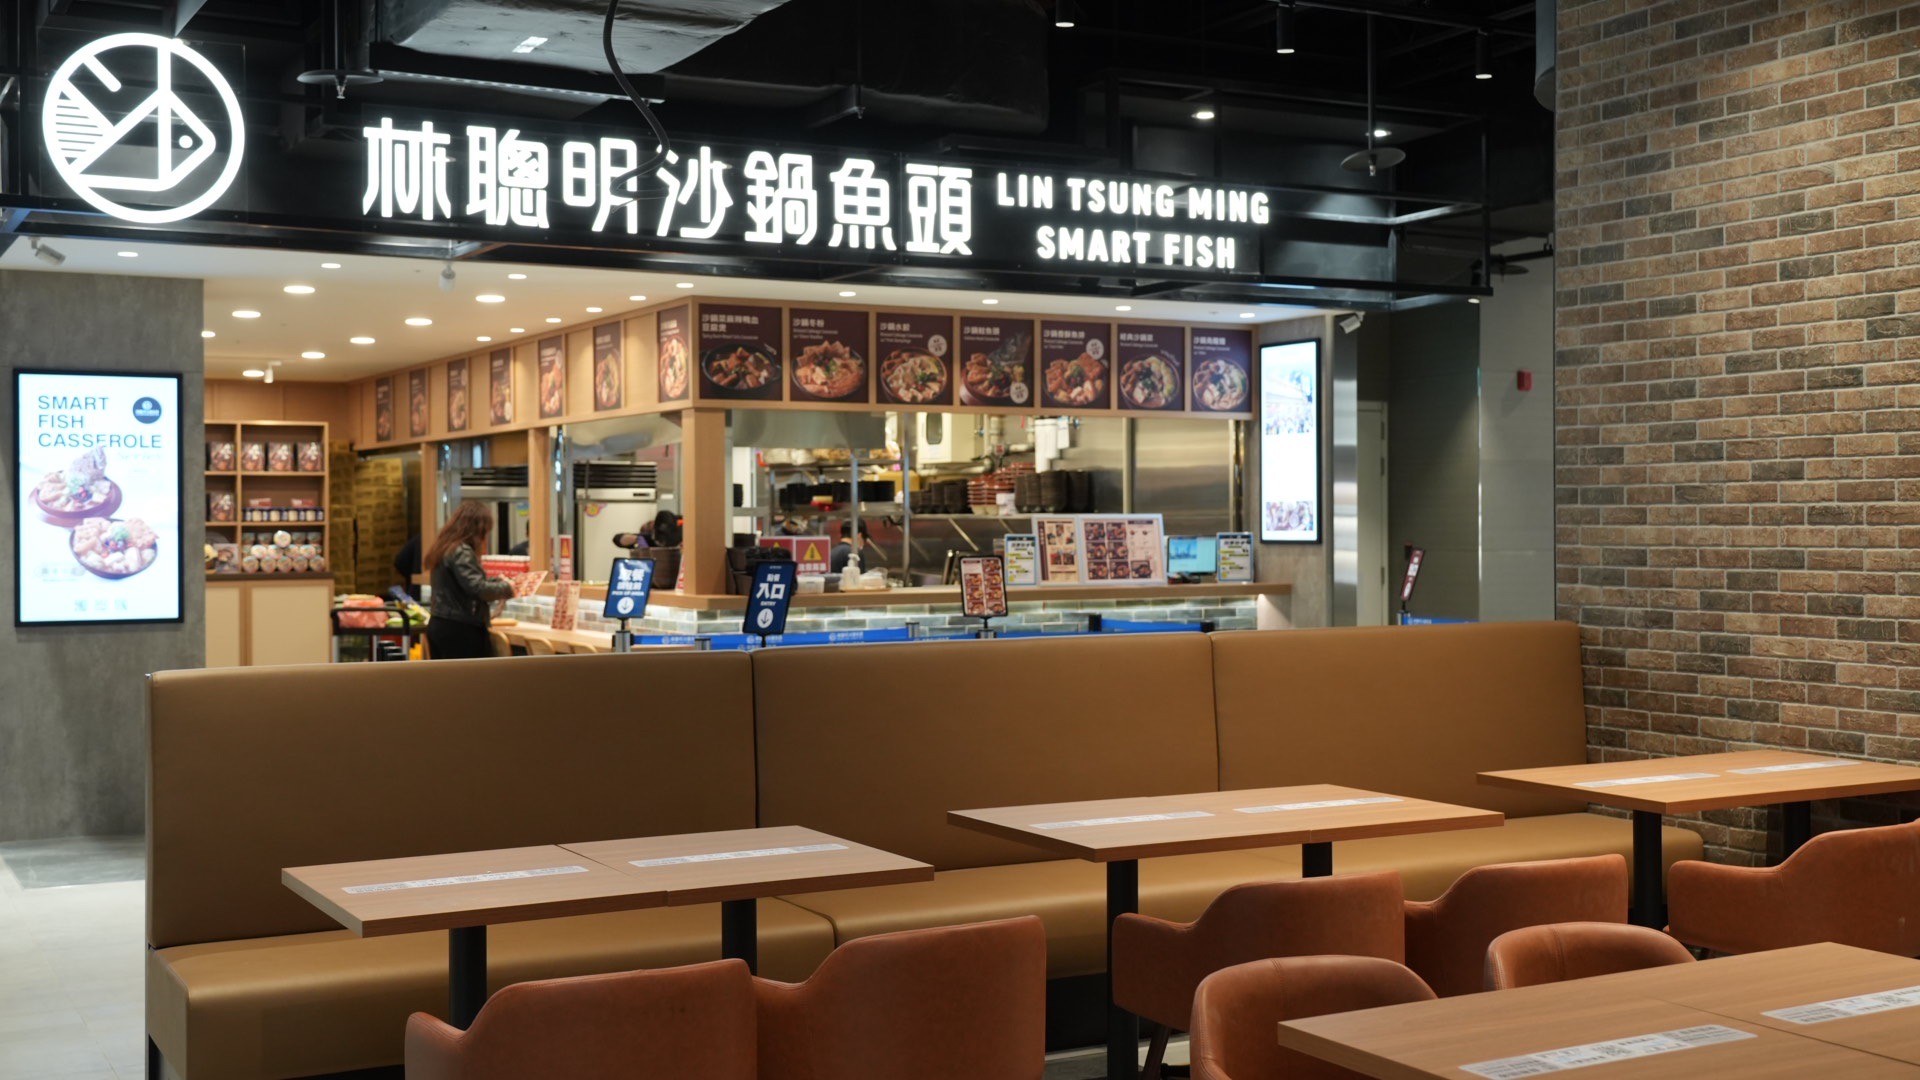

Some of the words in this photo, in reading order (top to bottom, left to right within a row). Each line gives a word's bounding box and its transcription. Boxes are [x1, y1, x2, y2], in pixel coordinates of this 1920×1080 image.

[363, 117, 973, 256] 林聰明沙鍋魚頭
[997, 172, 1053, 209] LIN
[1066, 177, 1175, 218] TSUNG
[1188, 186, 1270, 224] MING
[1036, 225, 1151, 264] SMART
[1163, 233, 1236, 269] FISH
[38, 395, 109, 410] SMART
[38, 414, 84, 429] FISH
[38, 432, 162, 448] CASSEROLE
[756, 582, 786, 600] 入口
